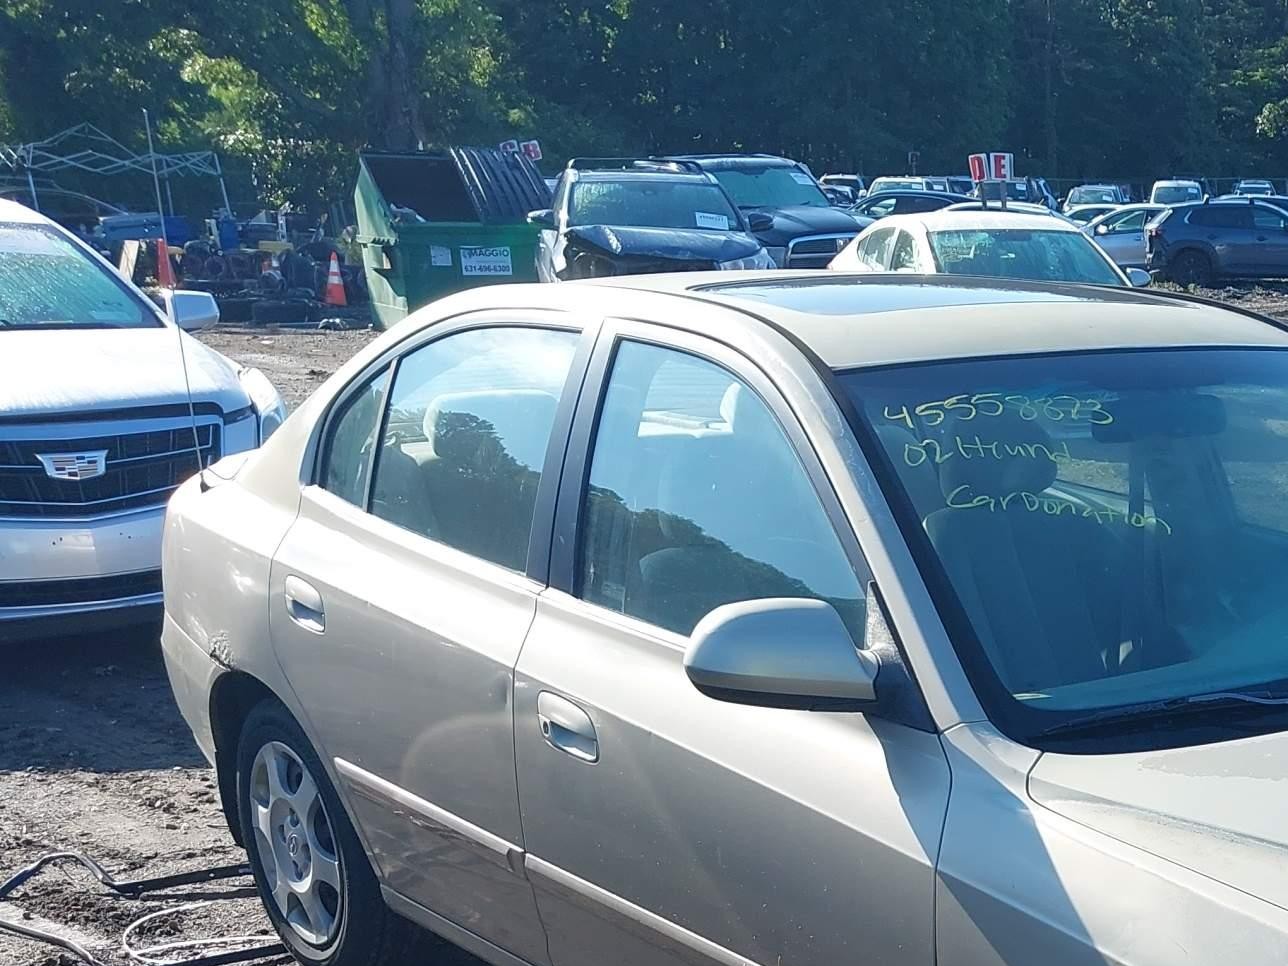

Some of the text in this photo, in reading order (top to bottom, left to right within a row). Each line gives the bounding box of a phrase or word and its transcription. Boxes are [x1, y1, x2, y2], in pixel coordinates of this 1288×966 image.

[994, 155, 1006, 178] E
[471, 248, 509, 258] MAGGIO
[883, 392, 1114, 429] 45558873
